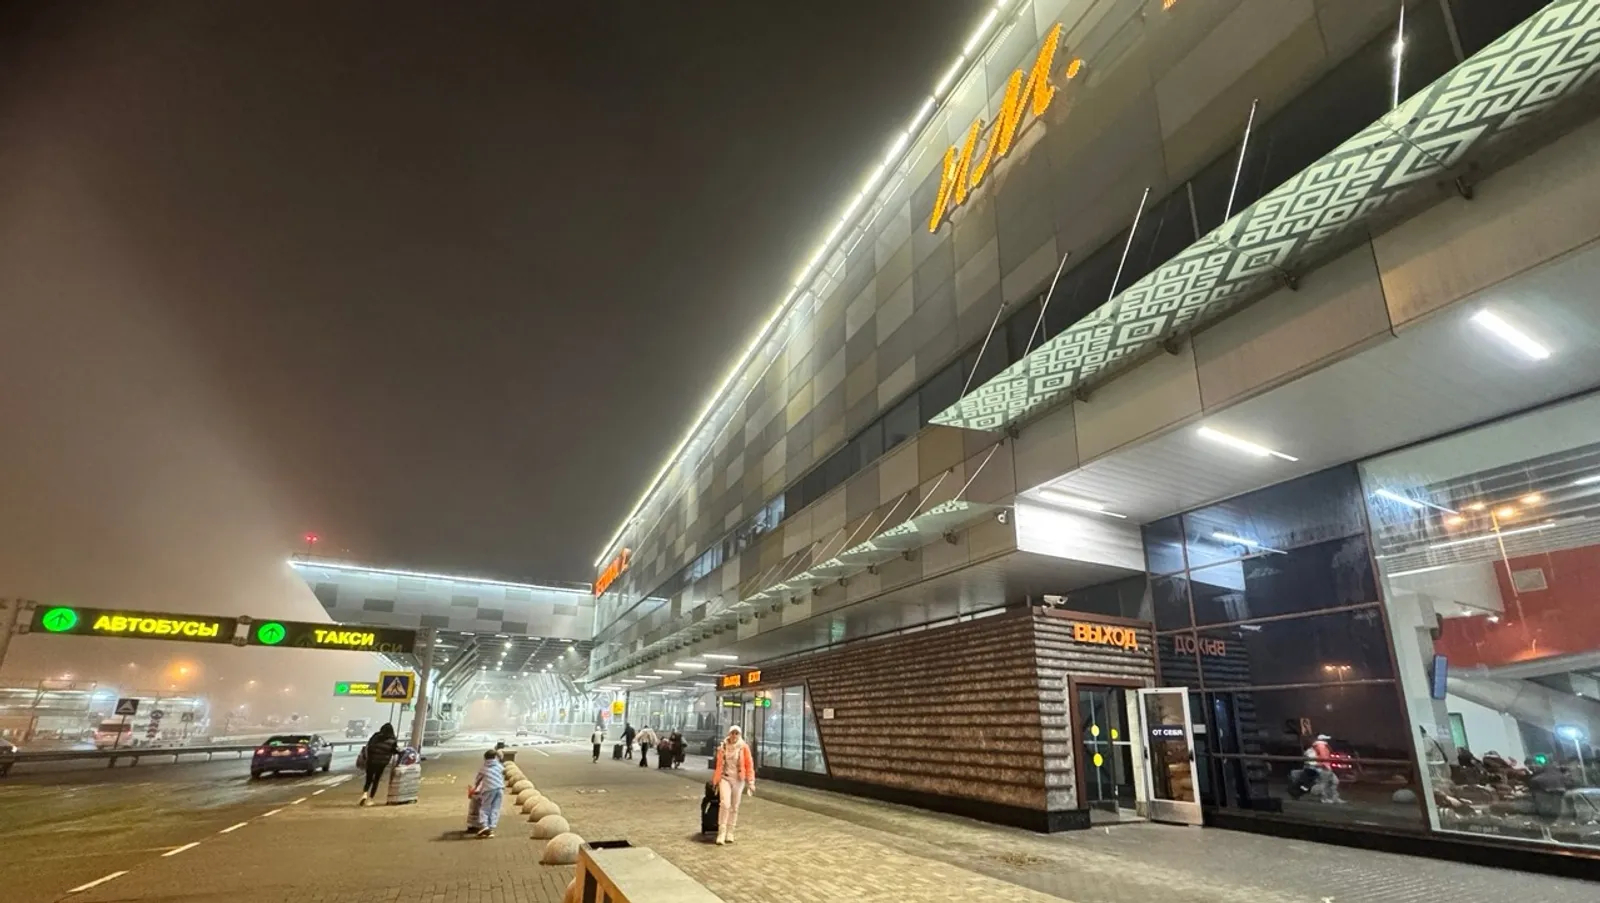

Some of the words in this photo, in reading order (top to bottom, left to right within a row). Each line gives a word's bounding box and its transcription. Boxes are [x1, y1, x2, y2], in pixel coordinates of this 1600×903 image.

[93, 614, 219, 637] АВТОБУСЫ
[1074, 623, 1138, 650] ВЫХОД
[314, 629, 375, 647] ТАКСИ
